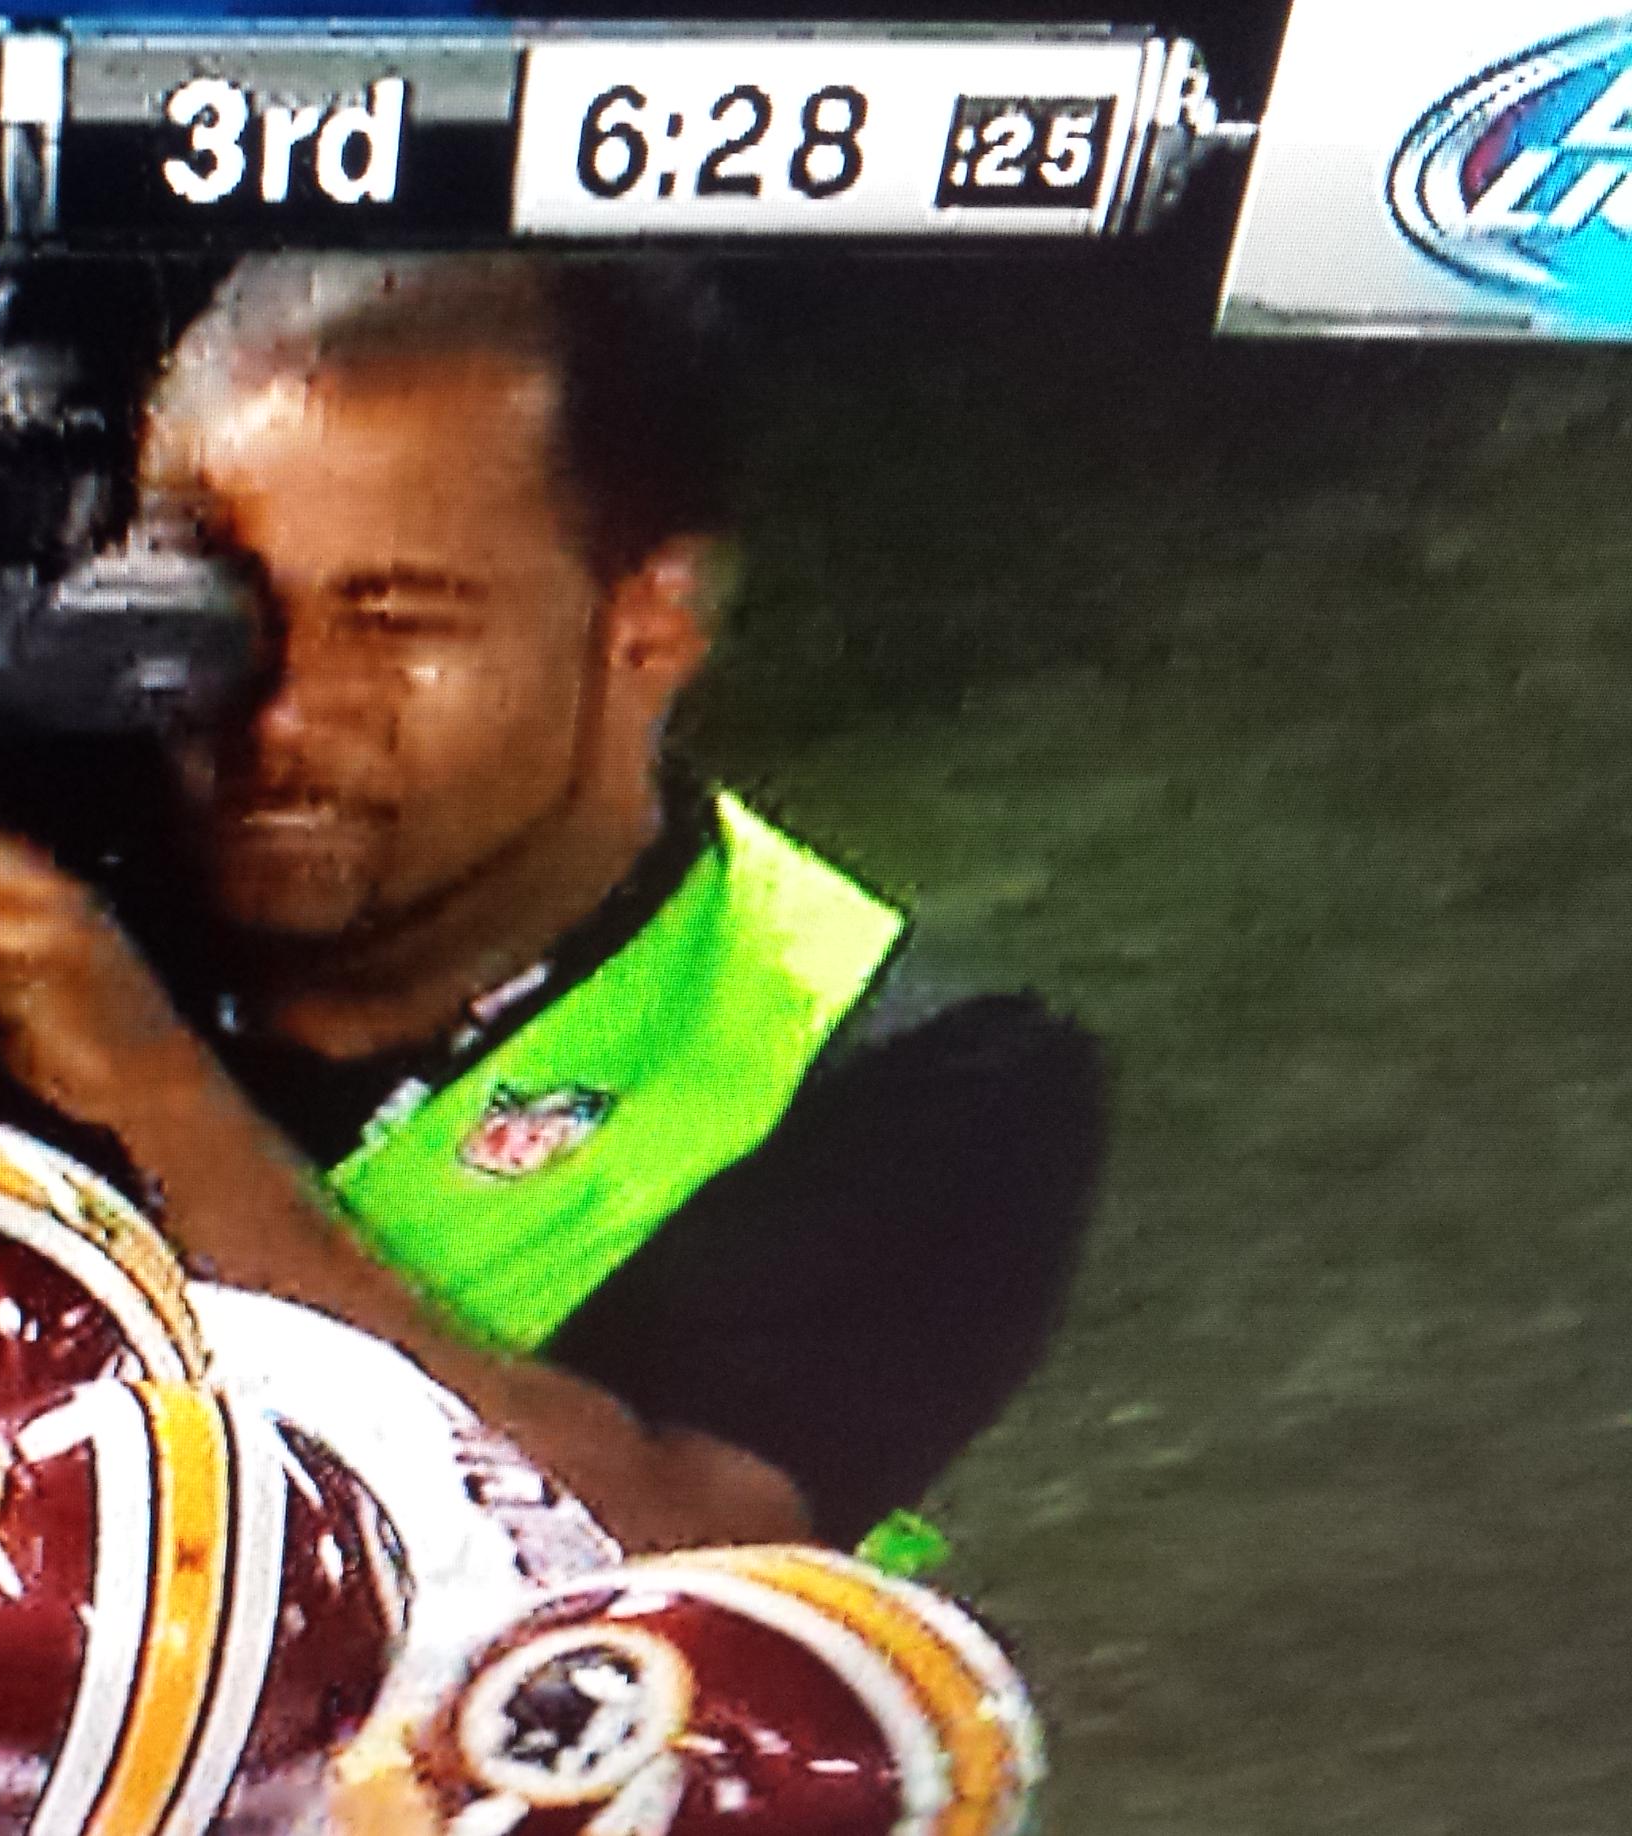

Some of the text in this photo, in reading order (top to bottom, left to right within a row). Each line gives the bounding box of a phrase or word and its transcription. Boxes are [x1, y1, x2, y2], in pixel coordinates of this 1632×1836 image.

[163, 77, 406, 203] 3rd
[576, 84, 868, 200] 6:28
[949, 114, 1099, 188] :25
